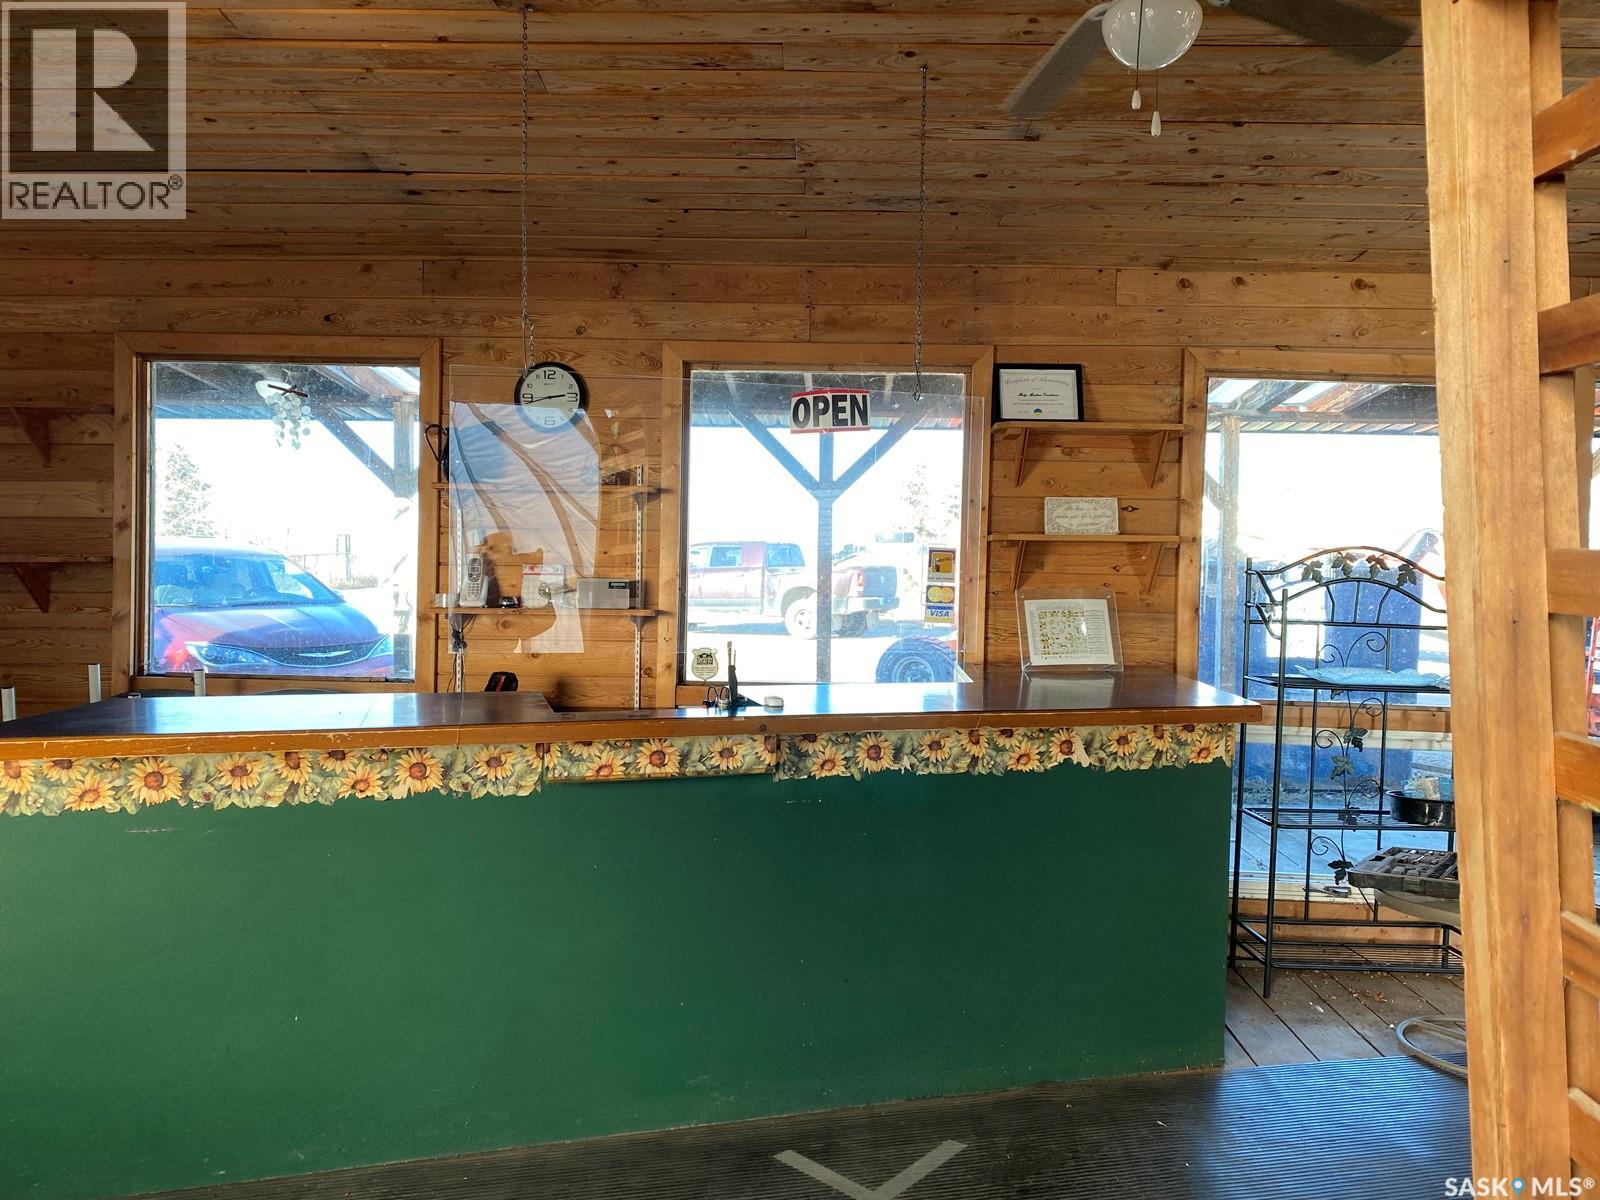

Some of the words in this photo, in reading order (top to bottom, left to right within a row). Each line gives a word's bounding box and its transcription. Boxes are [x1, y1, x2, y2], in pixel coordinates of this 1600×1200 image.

[543, 369, 557, 380] 12
[522, 392, 534, 403] 9
[566, 392, 579, 403] 3
[792, 394, 868, 429] OPEN
[544, 415, 556, 426] 6
[929, 609, 951, 618] VISA
